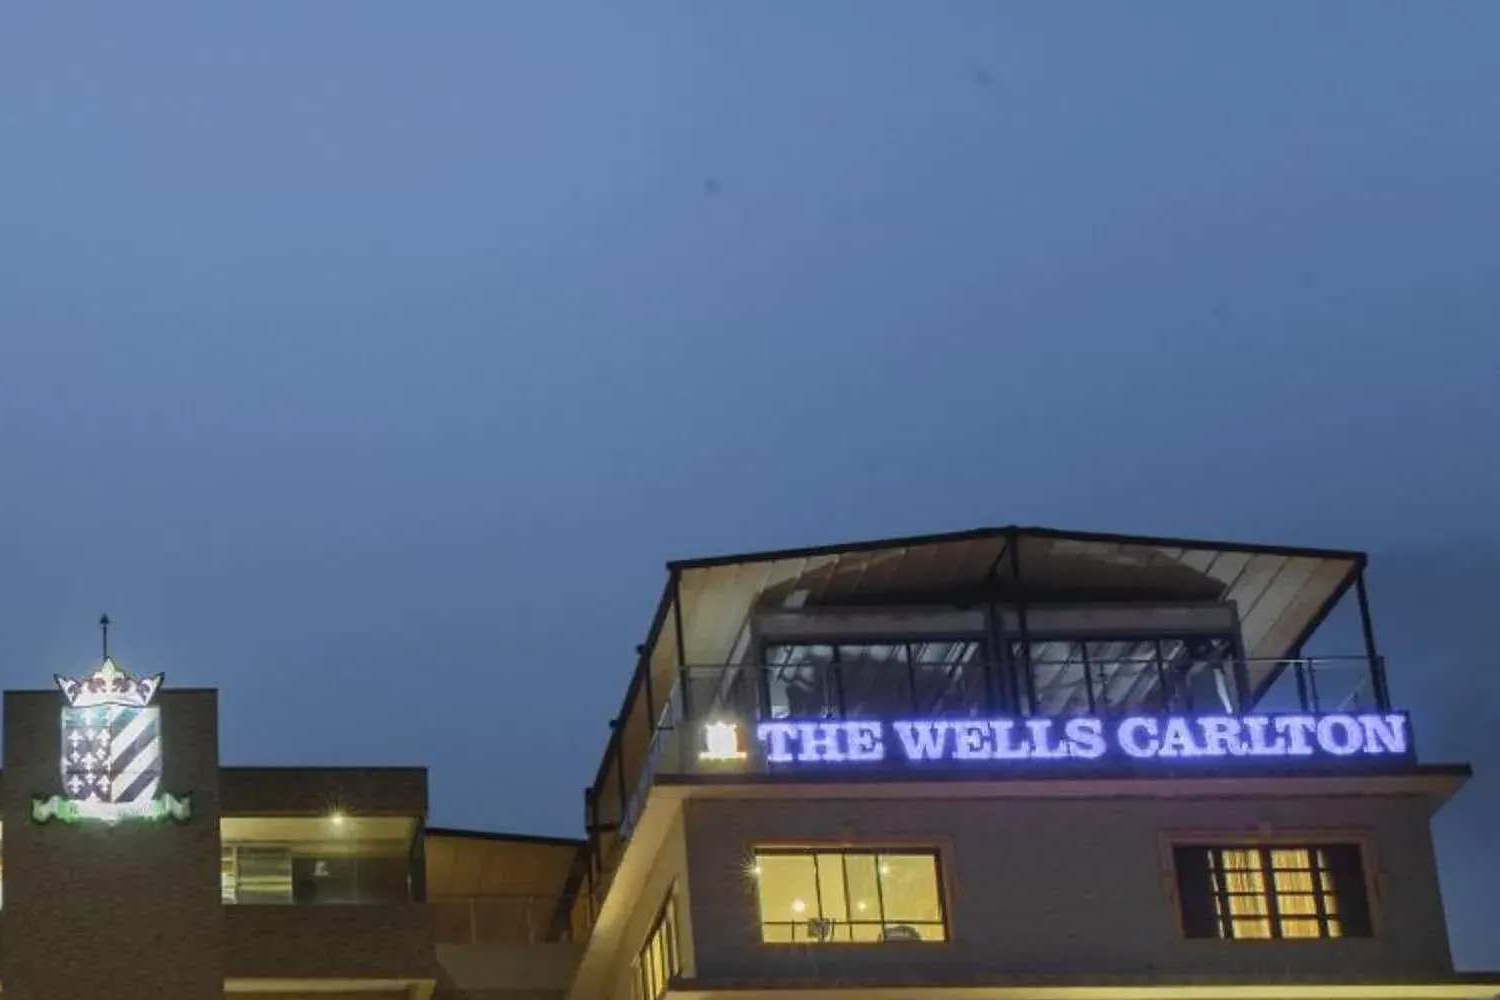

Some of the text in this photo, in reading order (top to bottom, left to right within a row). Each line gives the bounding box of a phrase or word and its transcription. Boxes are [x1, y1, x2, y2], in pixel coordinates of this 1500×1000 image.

[757, 713, 1408, 763] THE WELLS CARLTON
